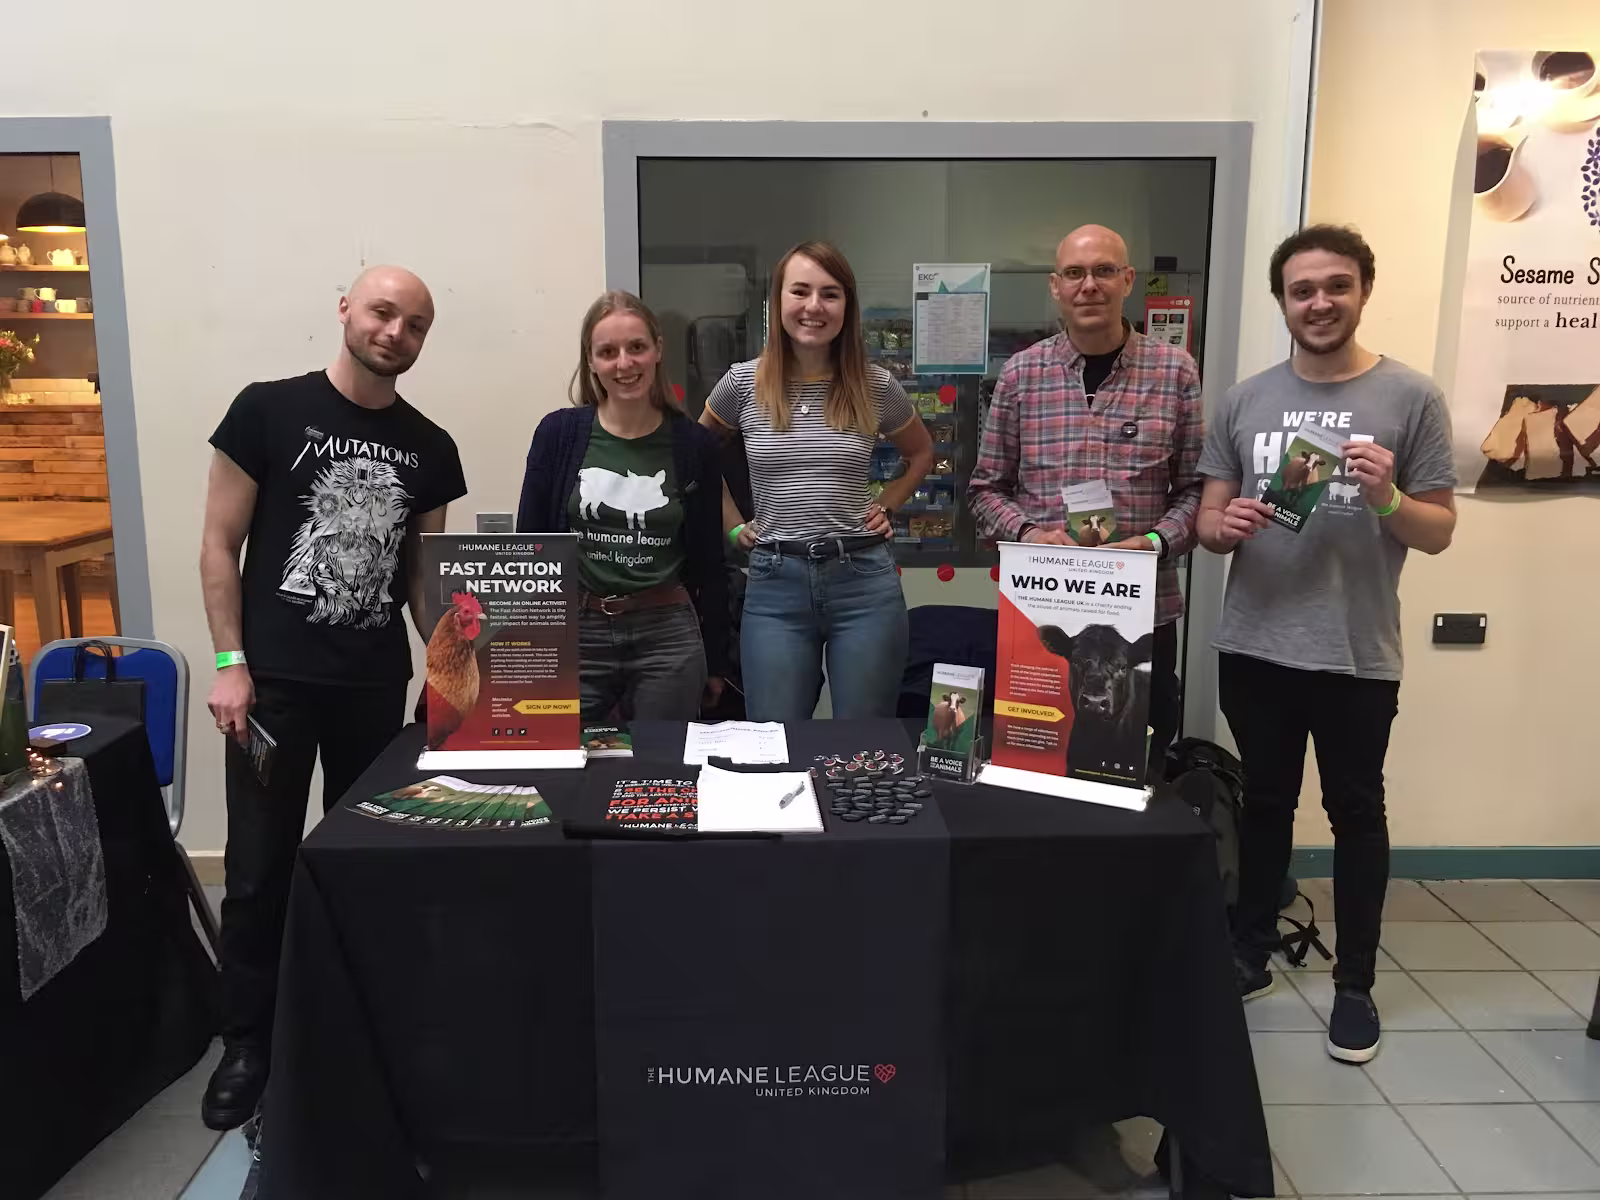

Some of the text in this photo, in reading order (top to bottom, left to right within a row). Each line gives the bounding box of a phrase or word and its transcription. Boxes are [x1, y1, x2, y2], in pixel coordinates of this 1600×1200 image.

[1500, 255, 1574, 284] Sesame
[1497, 295, 1535, 305] source
[1538, 293, 1552, 305] of
[1495, 318, 1540, 330] support
[1543, 319, 1550, 328] a
[1282, 411, 1353, 428] WE'RE
[290, 435, 419, 471] MUTATIONS
[1274, 511, 1299, 527] NIMALS
[1282, 509, 1302, 522] VOICE
[587, 528, 633, 544] humane
[637, 531, 672, 547] league
[586, 551, 654, 568] united kingdom
[1032, 556, 1075, 566] HUMANE
[1076, 559, 1115, 569] LEAGUE
[440, 562, 561, 576] FAST ACTION
[466, 580, 563, 593] NETWORK
[1011, 574, 1141, 598] WHO WE ARE
[1020, 707, 1055, 717] INVOLVED!
[935, 763, 962, 773] ANIMALS
[945, 758, 963, 767] VOICE
[609, 798, 649, 806] FOR
[658, 1066, 768, 1084] HUMANE
[775, 1064, 870, 1083] LEAGUE
[755, 1086, 870, 1097] UNITED KINGDOM
